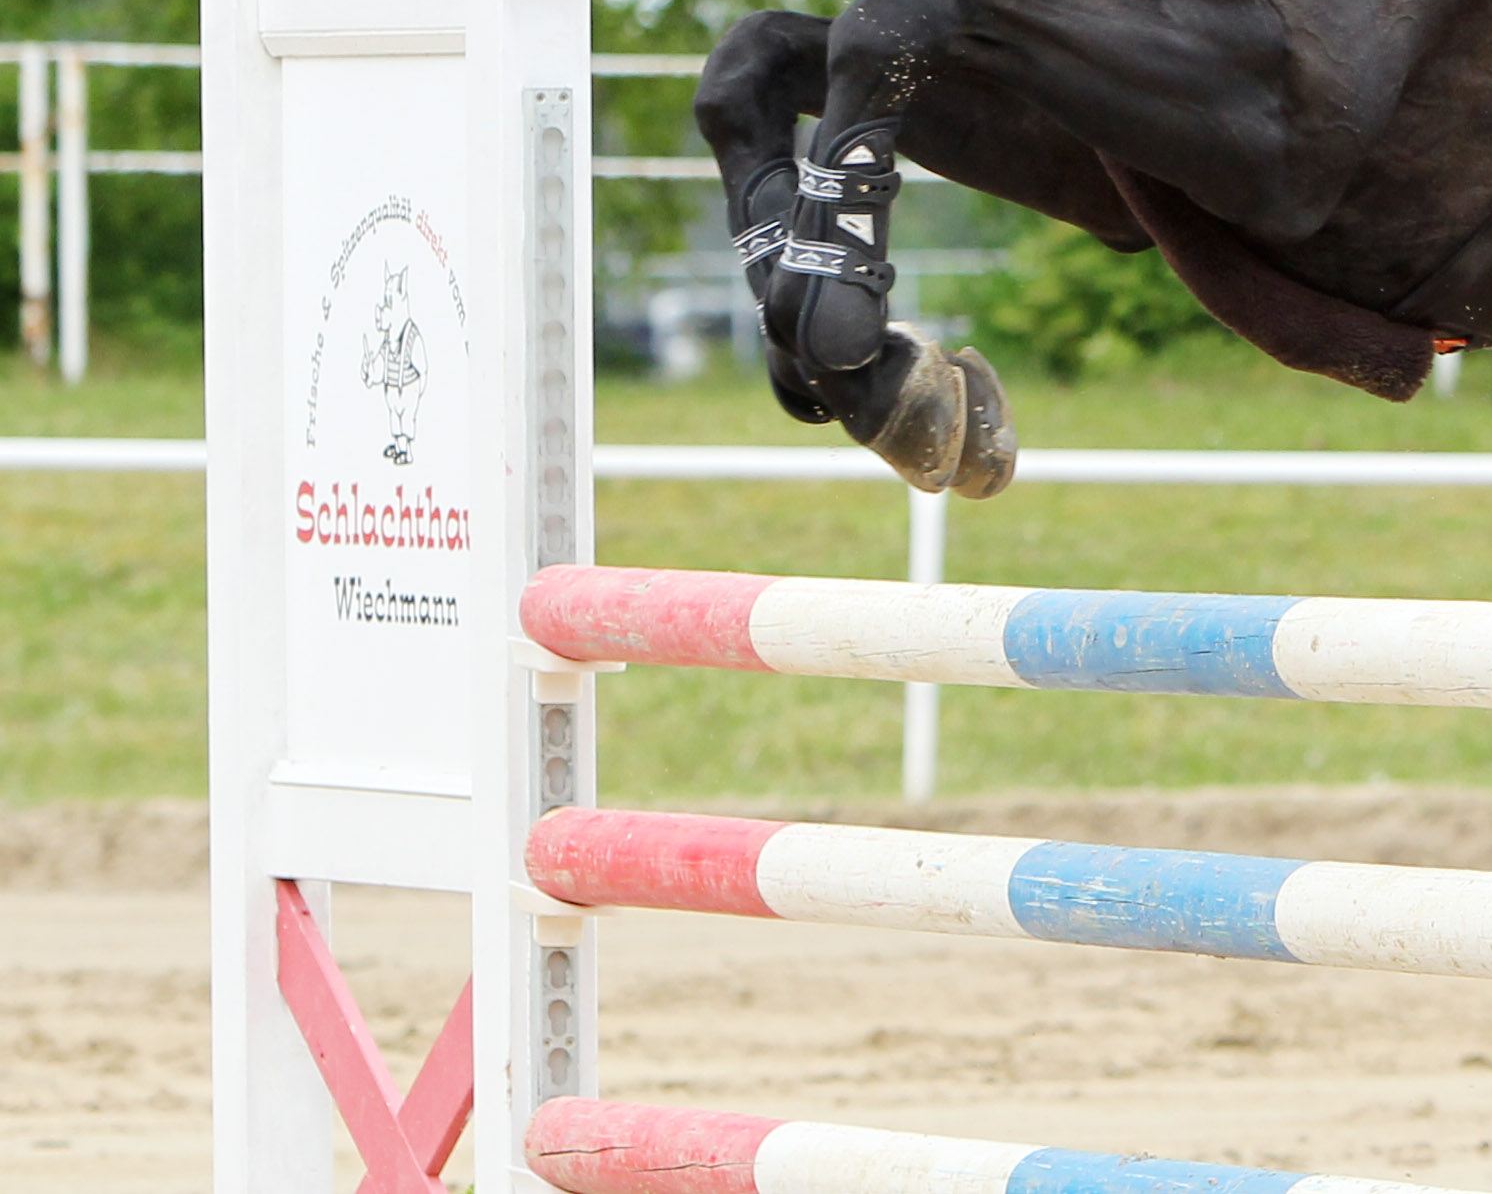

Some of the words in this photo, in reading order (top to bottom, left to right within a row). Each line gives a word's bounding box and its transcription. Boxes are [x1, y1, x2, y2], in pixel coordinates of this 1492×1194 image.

[330, 194, 412, 290] Spitzenqualität
[415, 209, 448, 269] direkt
[334, 576, 459, 626] Wiechmann
